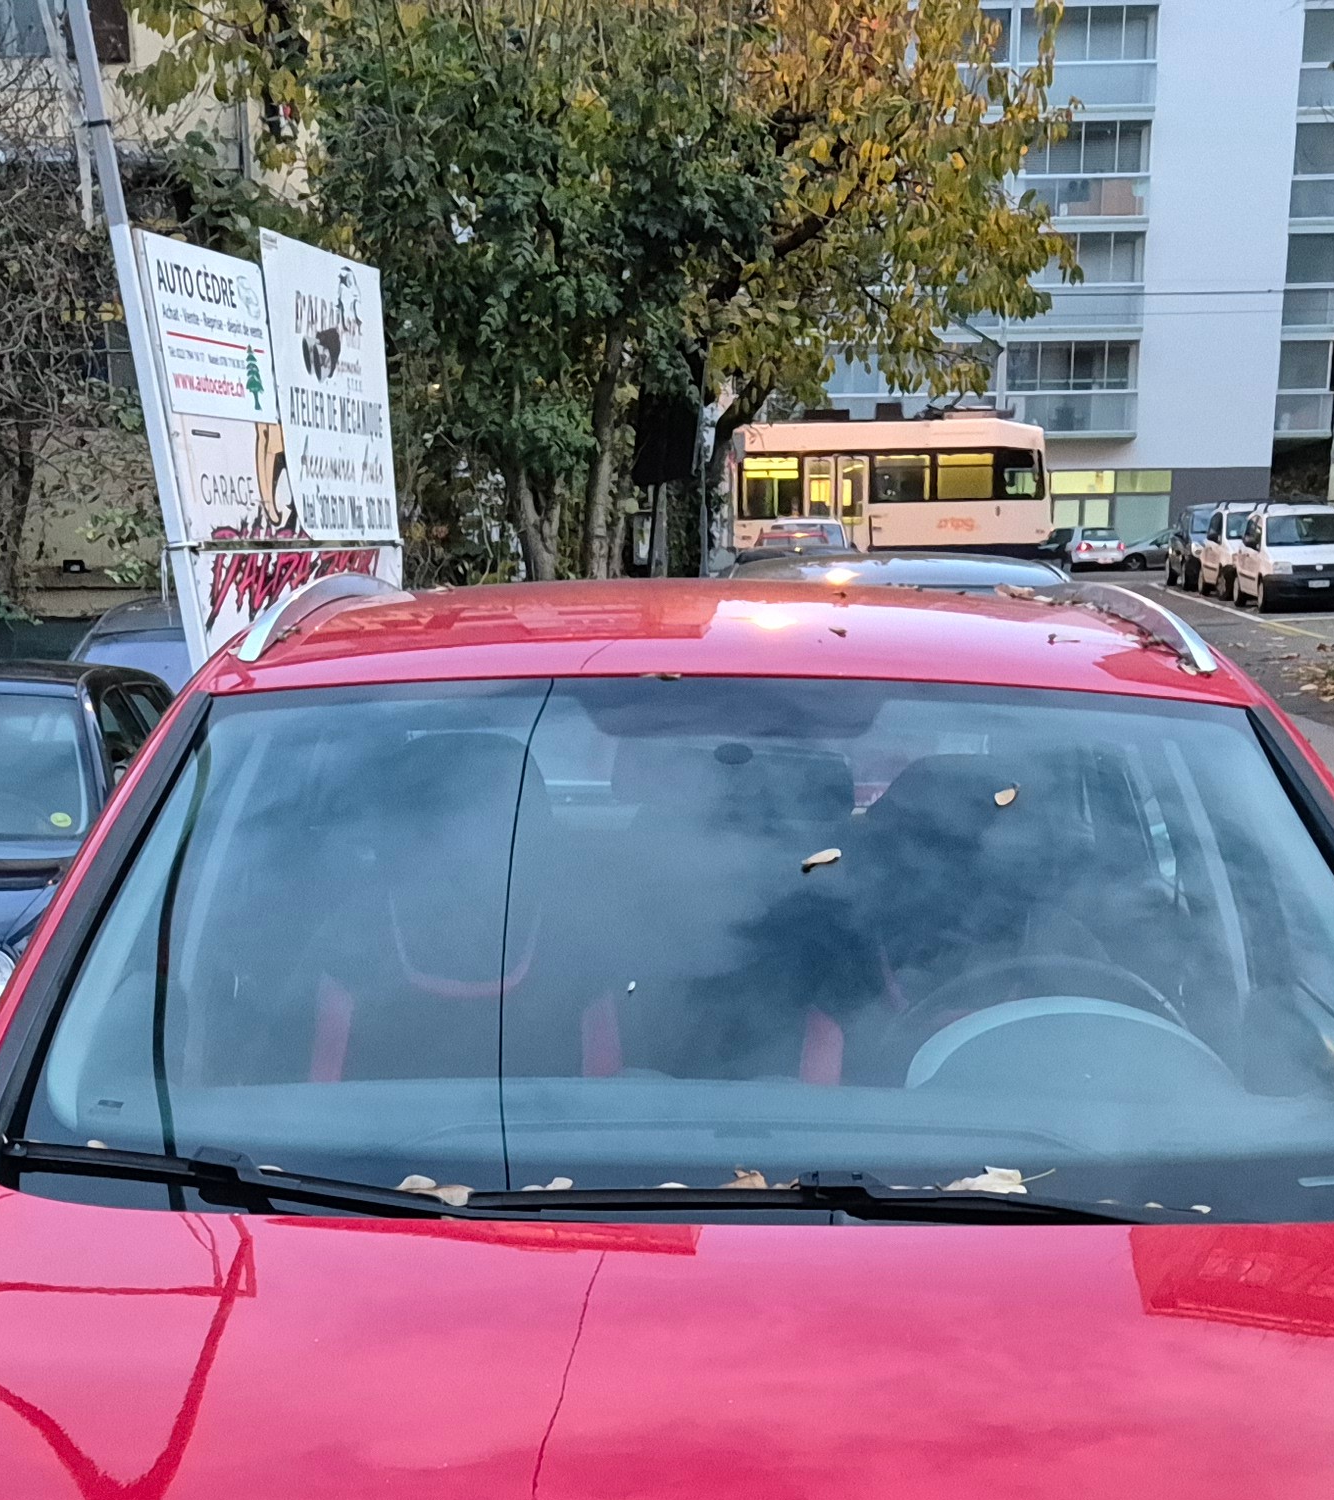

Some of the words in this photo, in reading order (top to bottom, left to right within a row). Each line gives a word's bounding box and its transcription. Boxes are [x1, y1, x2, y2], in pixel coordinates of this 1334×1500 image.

[156, 258, 194, 299] AUTO
[196, 263, 237, 309] CÈDRE
[290, 386, 326, 431] ATELIER
[327, 393, 338, 433] DE
[200, 473, 256, 507] GARAGE
